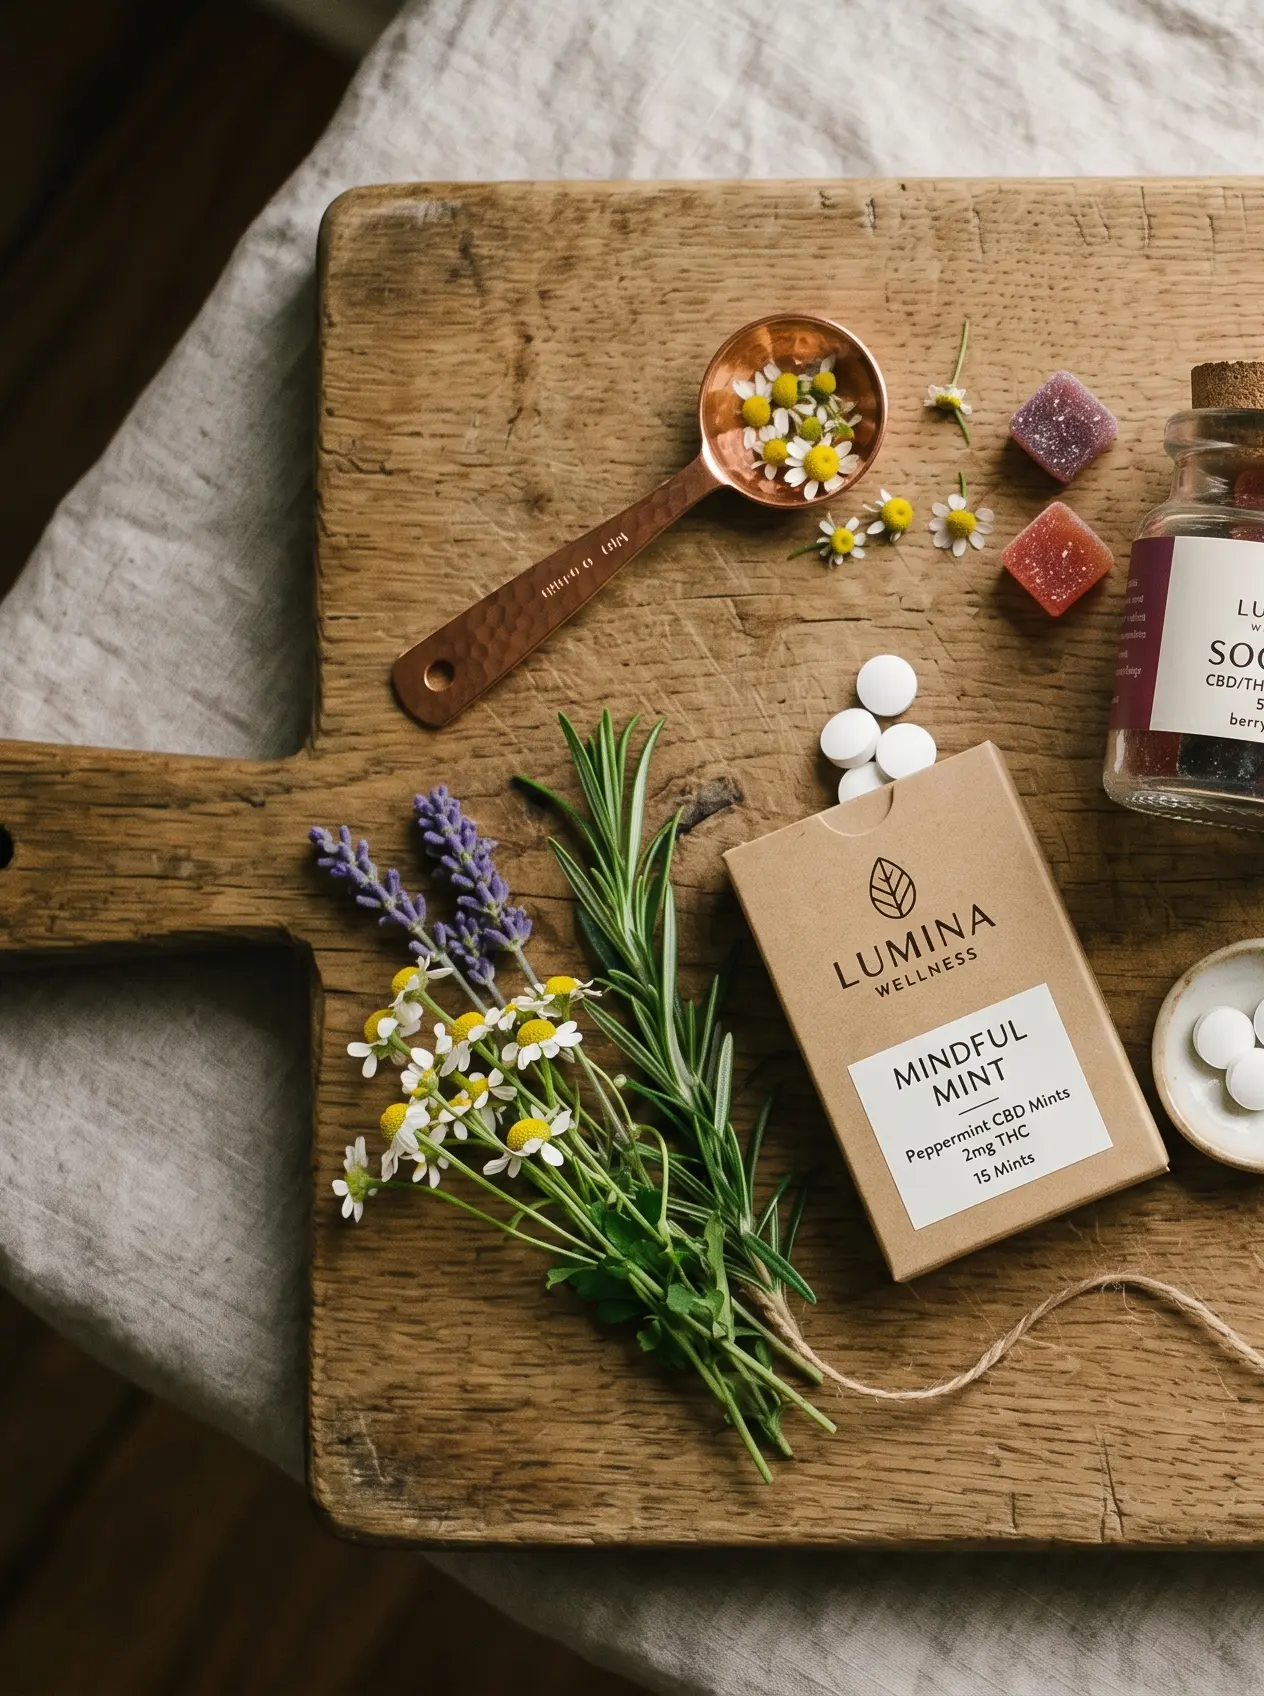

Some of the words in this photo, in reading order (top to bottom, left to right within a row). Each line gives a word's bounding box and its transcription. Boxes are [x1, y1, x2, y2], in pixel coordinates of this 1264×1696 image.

[832, 903, 996, 989] LUMINA
[875, 947, 978, 998] WELLNESS
[893, 1019, 1028, 1090] MINDFUL
[932, 1057, 1005, 1107] MINT
[905, 1119, 991, 1163] Peppermint
[992, 1104, 1026, 1127] CBD
[1029, 1087, 1071, 1113] Mints
[961, 1141, 997, 1162] 2mg
[995, 1124, 1030, 1148] THC
[973, 1169, 991, 1185] 15
[993, 1153, 1036, 1179] Mints
